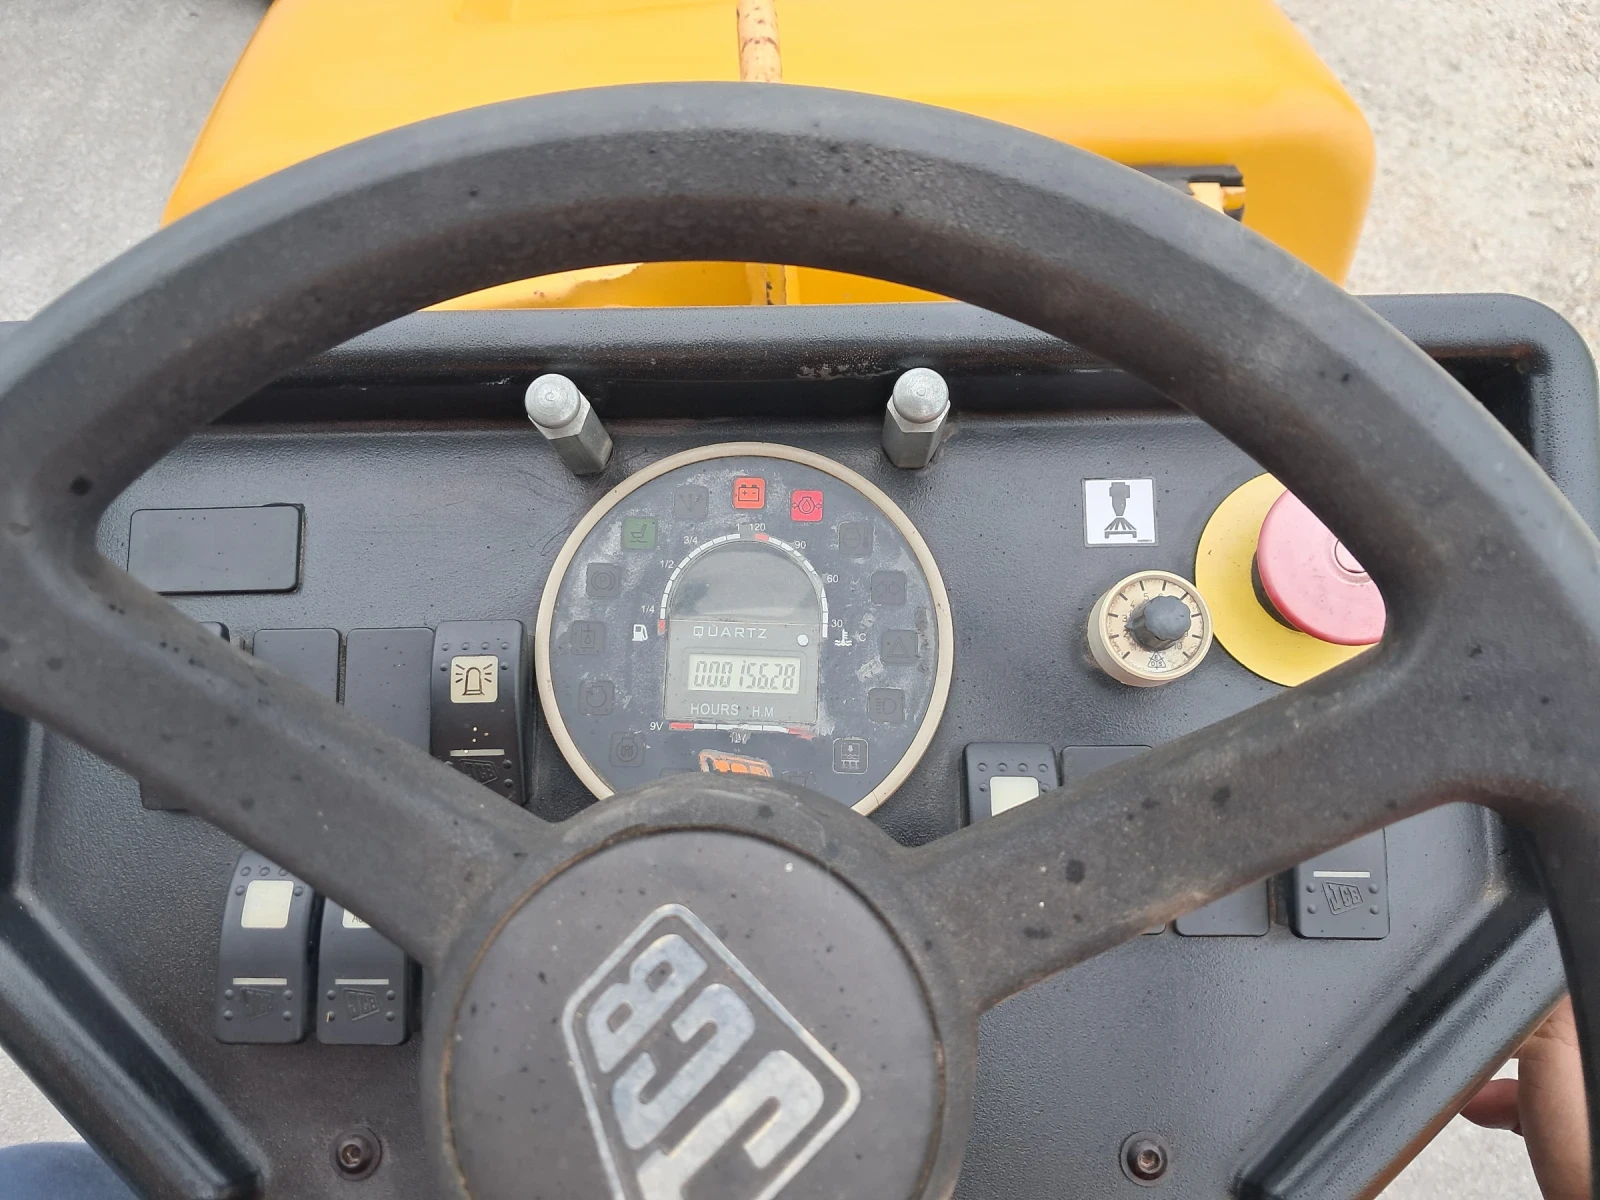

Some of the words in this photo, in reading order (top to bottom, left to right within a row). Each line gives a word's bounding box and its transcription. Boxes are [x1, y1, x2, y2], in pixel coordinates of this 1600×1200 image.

[749, 523, 766, 531] 120
[683, 536, 698, 545] 3/4
[794, 541, 807, 549] 90
[660, 560, 675, 569] 1/2
[826, 574, 839, 583] 60
[641, 605, 655, 614] 1/4
[831, 619, 843, 628] 30
[693, 625, 768, 639] QUARTZ
[690, 703, 740, 716] HOURS
[752, 706, 774, 718] H.M
[649, 721, 663, 731] 9V
[1326, 884, 1362, 912] JCB
[587, 933, 824, 1200] JCB
